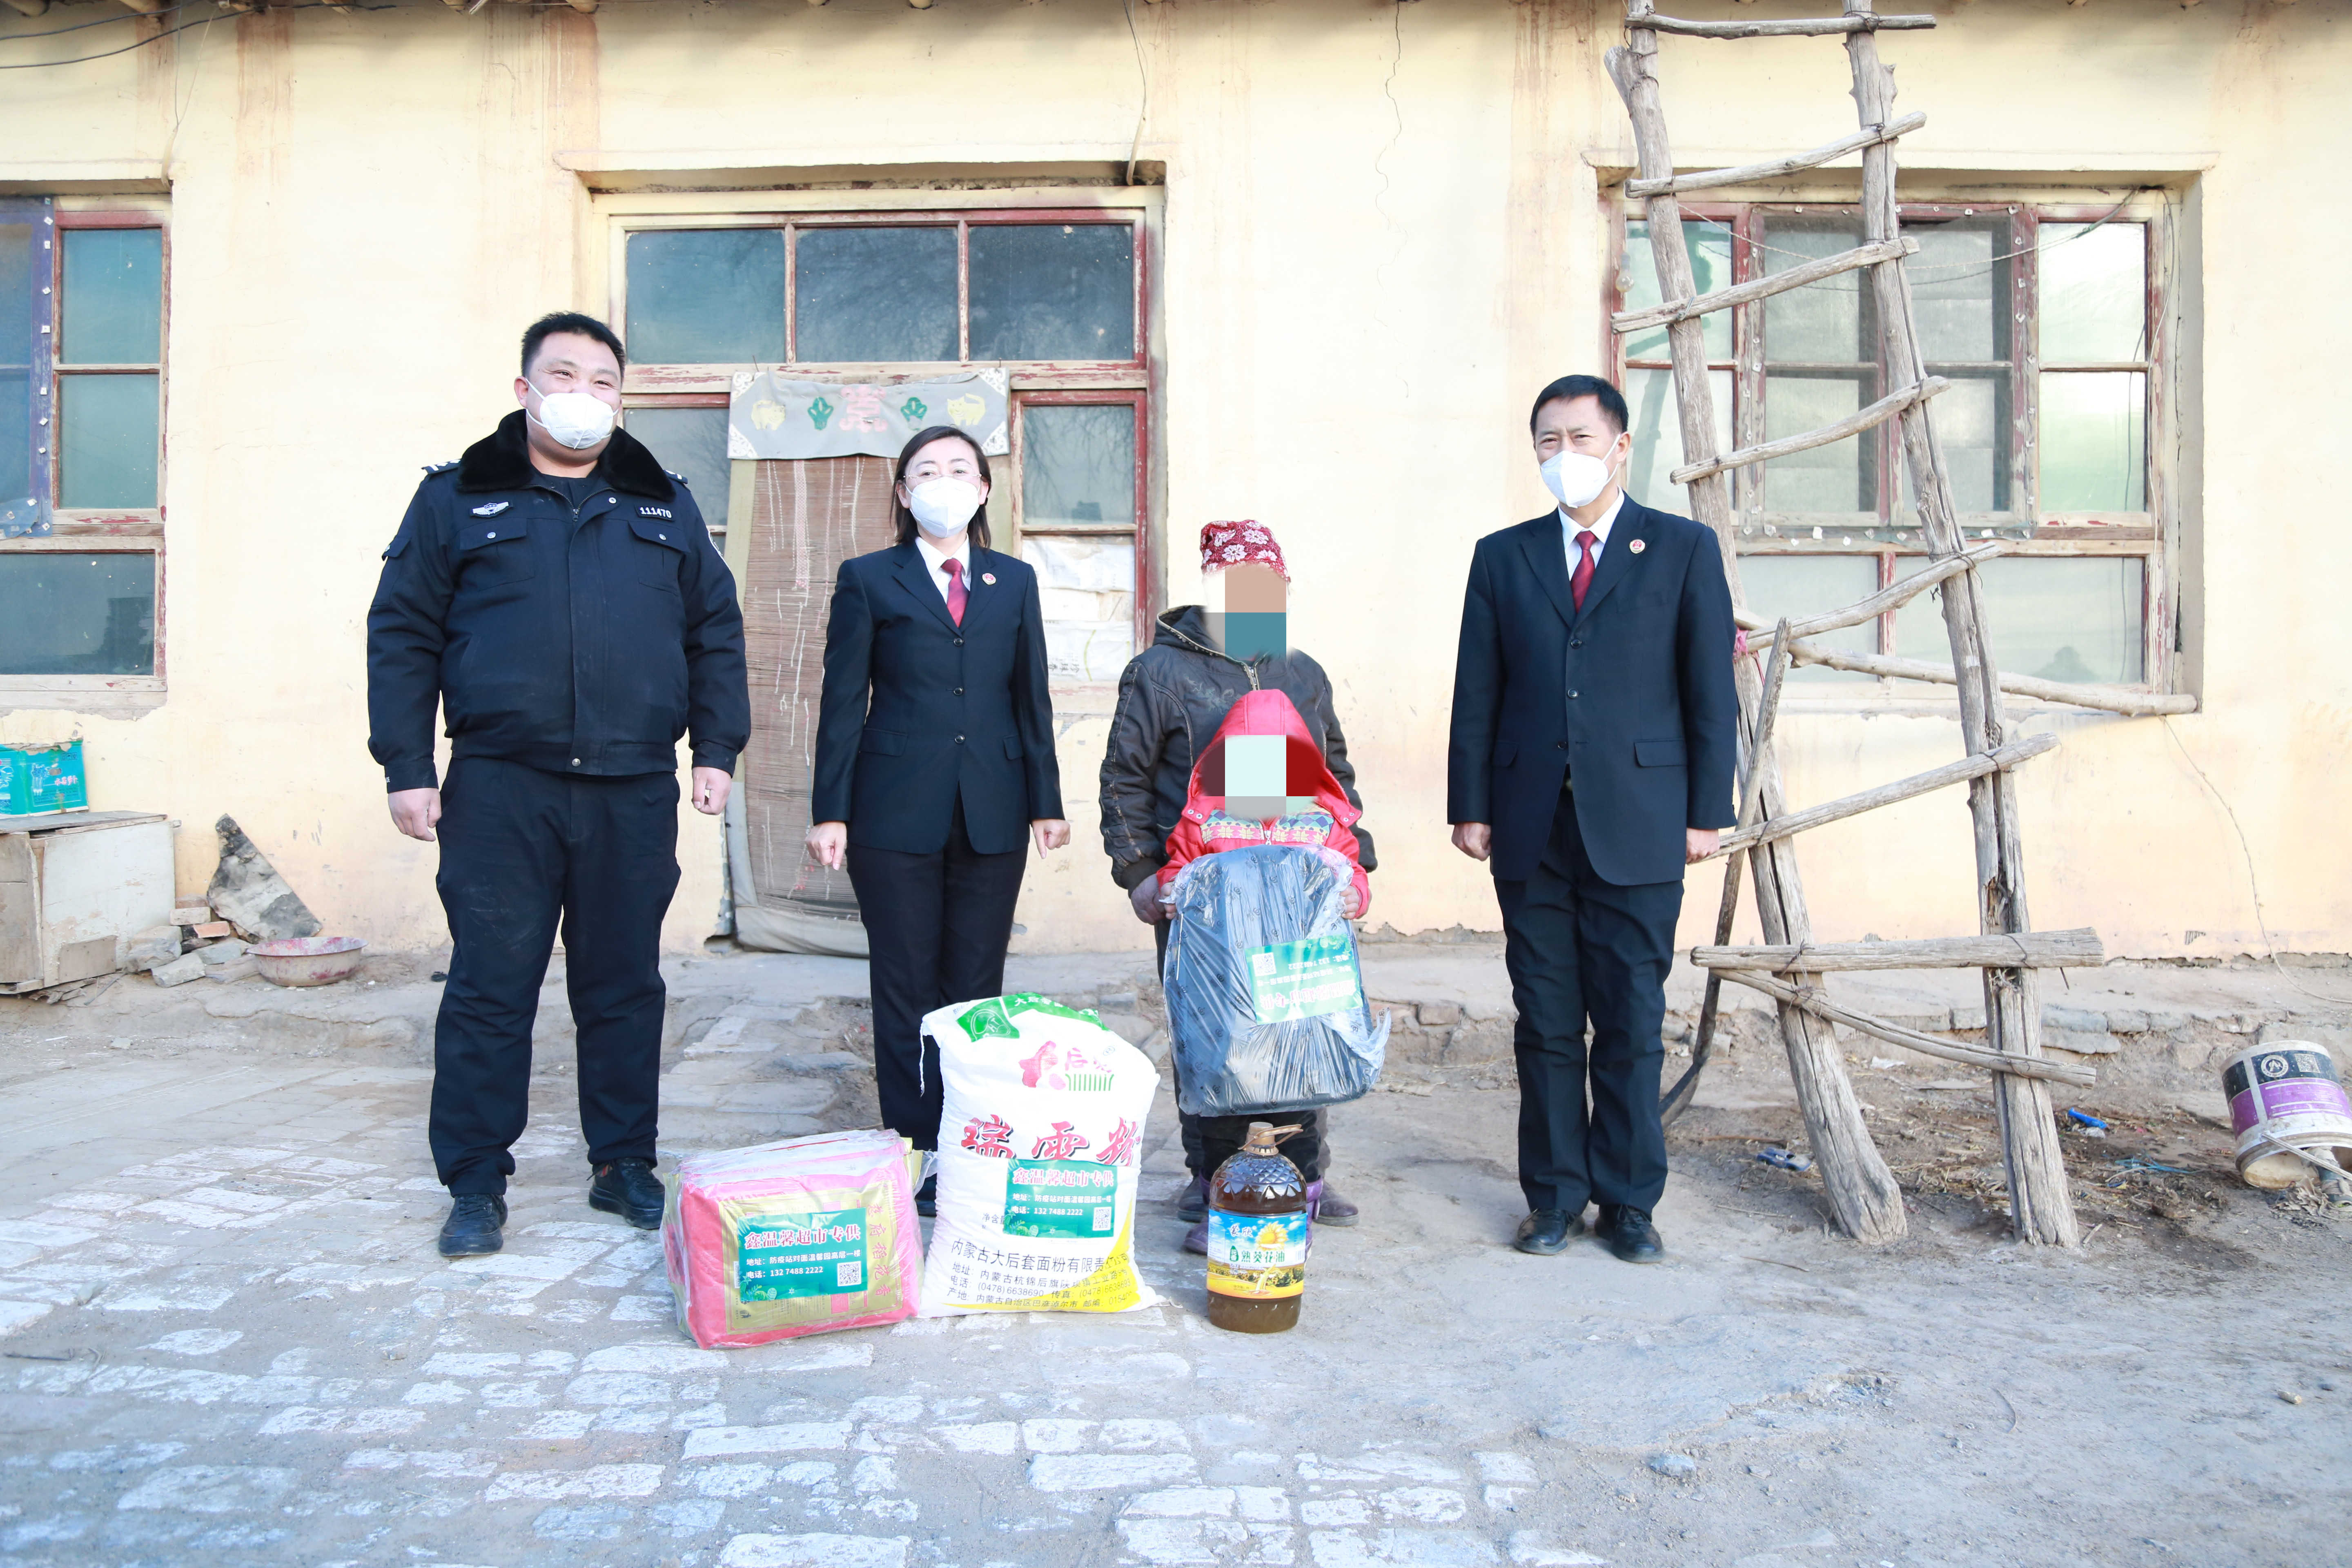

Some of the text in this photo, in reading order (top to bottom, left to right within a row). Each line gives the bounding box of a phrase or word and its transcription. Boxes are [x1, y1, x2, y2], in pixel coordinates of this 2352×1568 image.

[640, 507, 672, 518] 111470
[1012, 1167, 1114, 1187] 鑫温馨超市专供
[744, 1224, 861, 1250] 鑫温馨超市专供
[1241, 1250, 1285, 1263] 熟葵花油
